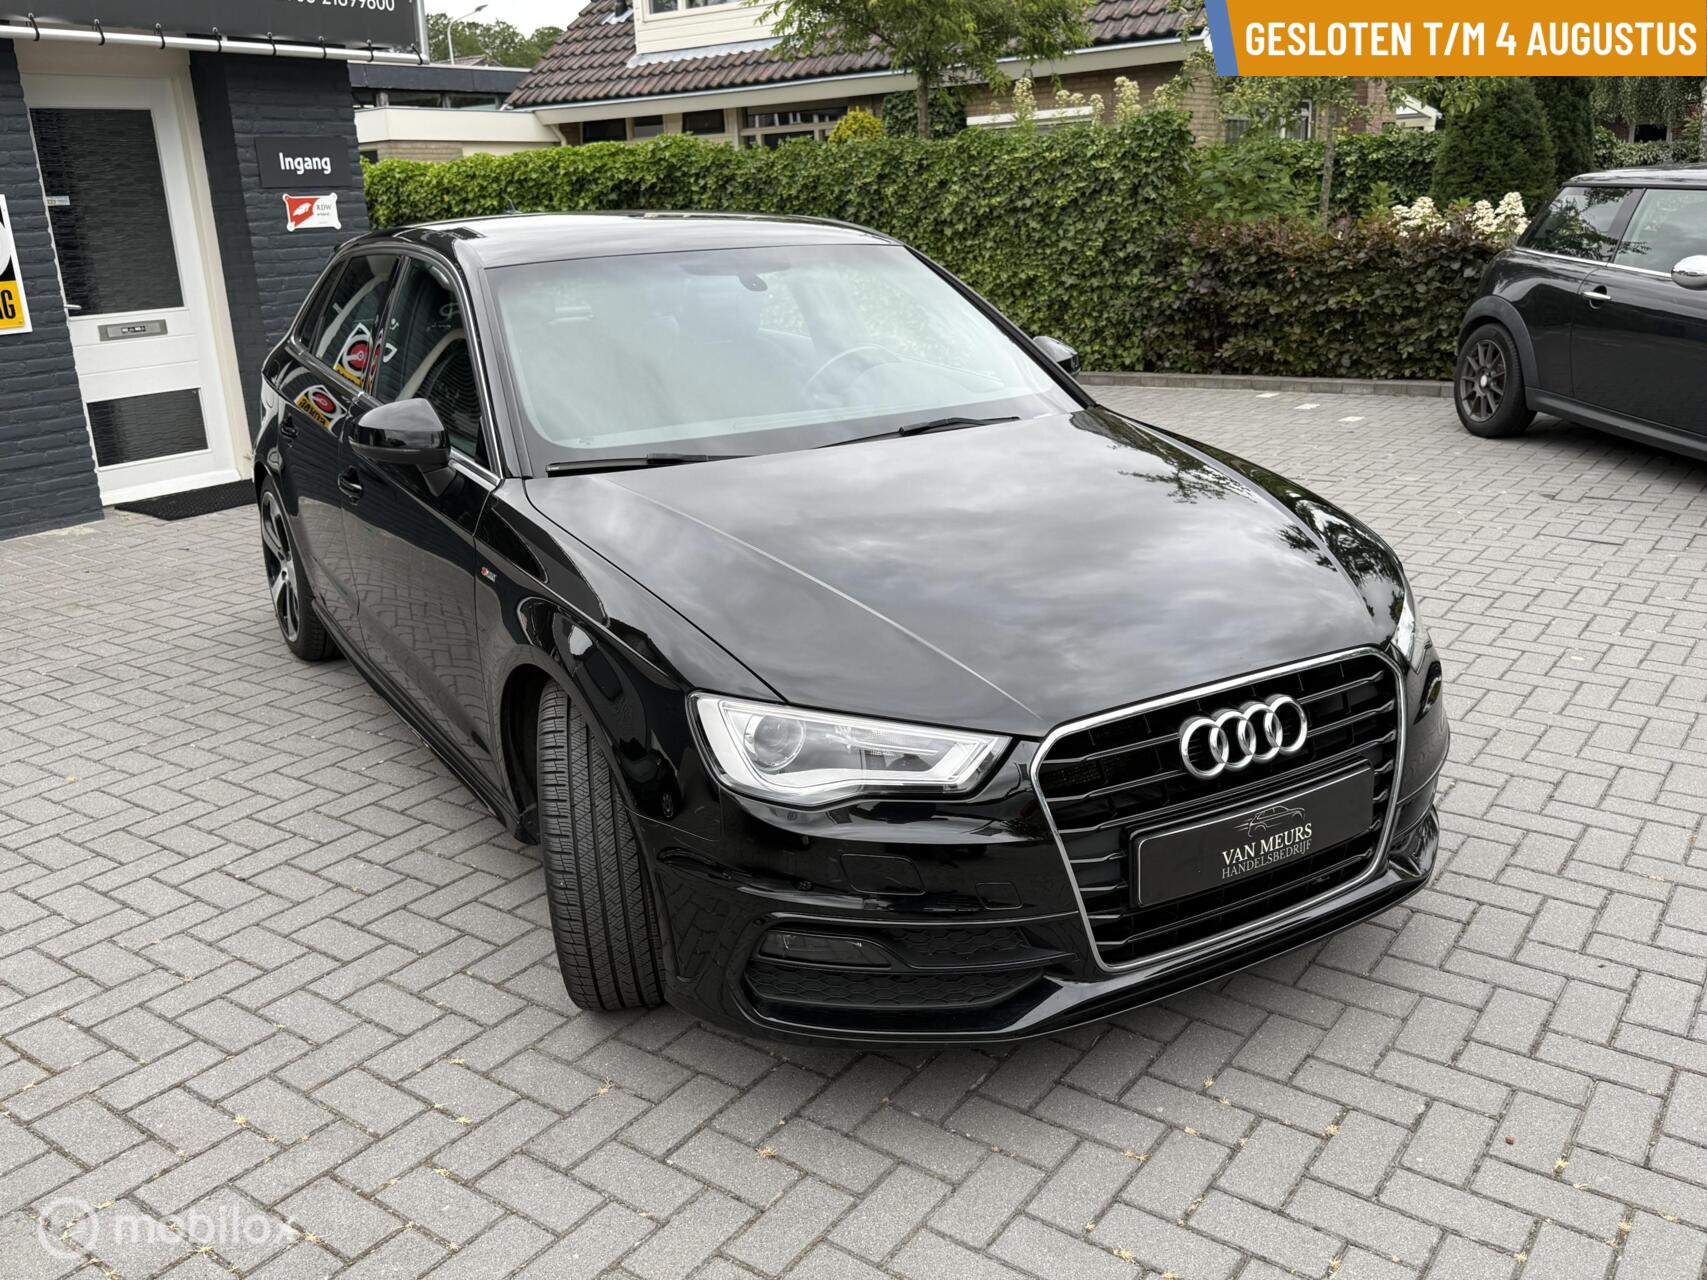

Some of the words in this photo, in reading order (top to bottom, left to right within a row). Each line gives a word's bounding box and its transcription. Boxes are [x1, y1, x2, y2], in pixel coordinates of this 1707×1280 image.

[279, 152, 332, 175] Ingang
[0, 289, 16, 320] G
[1222, 842, 1256, 865] VAN
[1260, 823, 1312, 855] MEURS
[1222, 839, 1312, 879] HANDELSBEDRIJF
